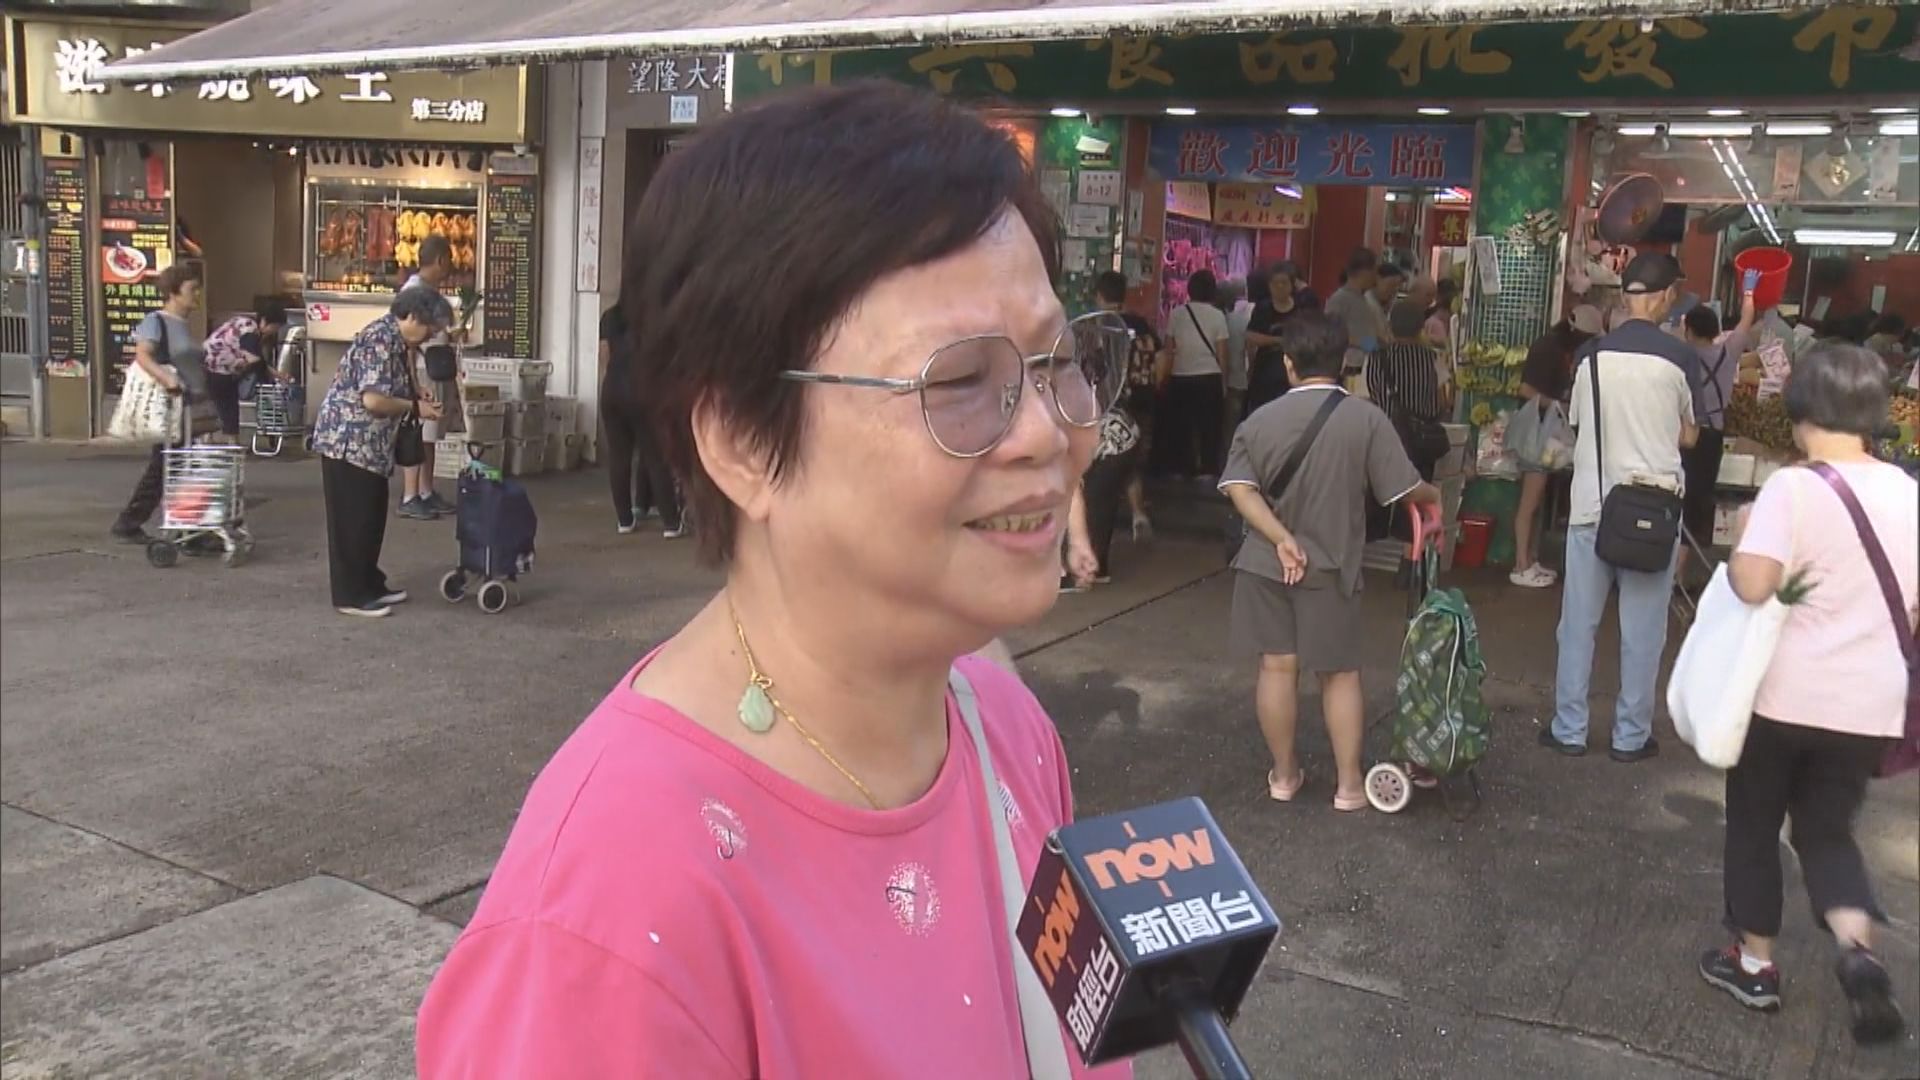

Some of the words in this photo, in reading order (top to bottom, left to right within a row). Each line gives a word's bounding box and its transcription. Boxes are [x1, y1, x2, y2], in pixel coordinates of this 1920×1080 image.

[411, 97, 485, 122] 第三分店
[1177, 127, 1447, 180] 歡迎光臨
[1084, 827, 1215, 889] now
[1033, 868, 1080, 988] now
[1120, 890, 1263, 956] 新聞台
[1065, 935, 1120, 1051] 財經台
